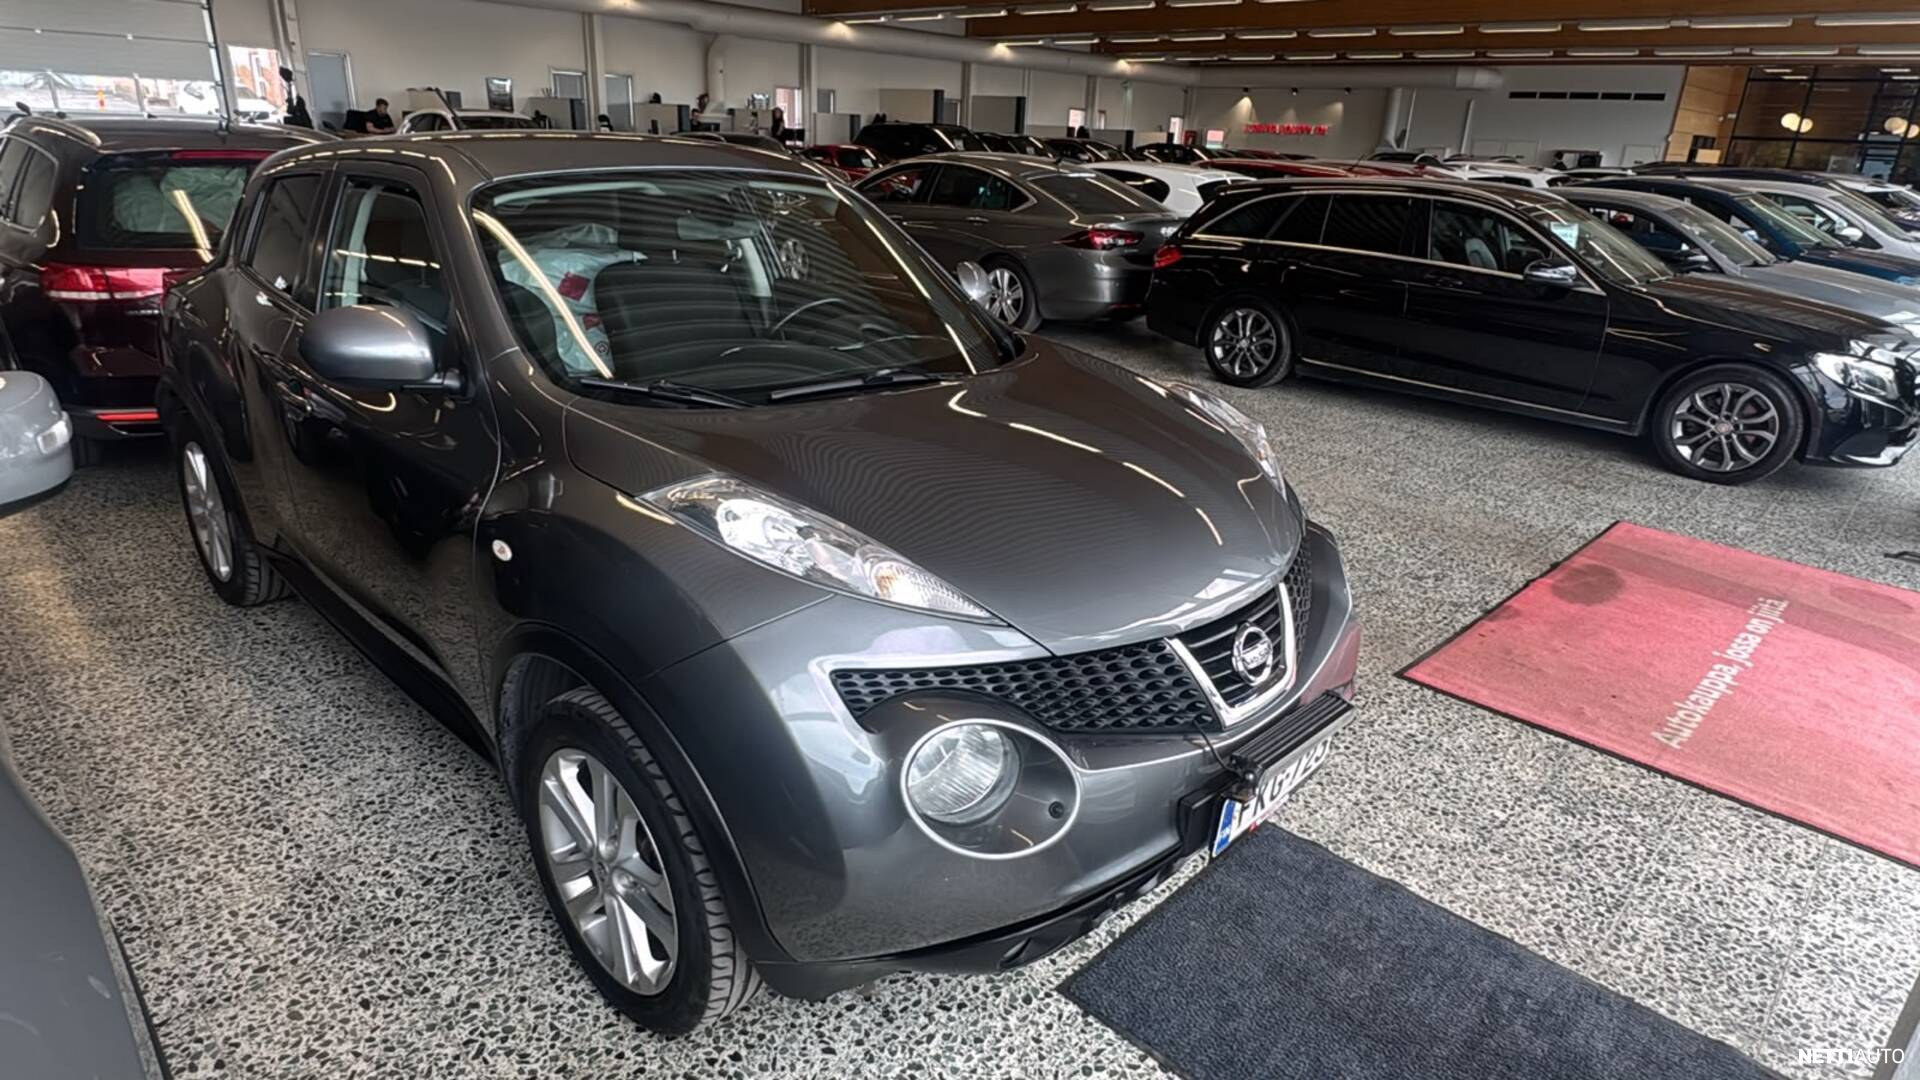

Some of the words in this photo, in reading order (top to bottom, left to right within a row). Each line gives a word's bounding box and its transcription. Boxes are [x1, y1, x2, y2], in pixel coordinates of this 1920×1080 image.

[1651, 664, 1744, 750] Autokauppa,
[1712, 632, 1763, 668] jossa
[1745, 618, 1775, 635] on
